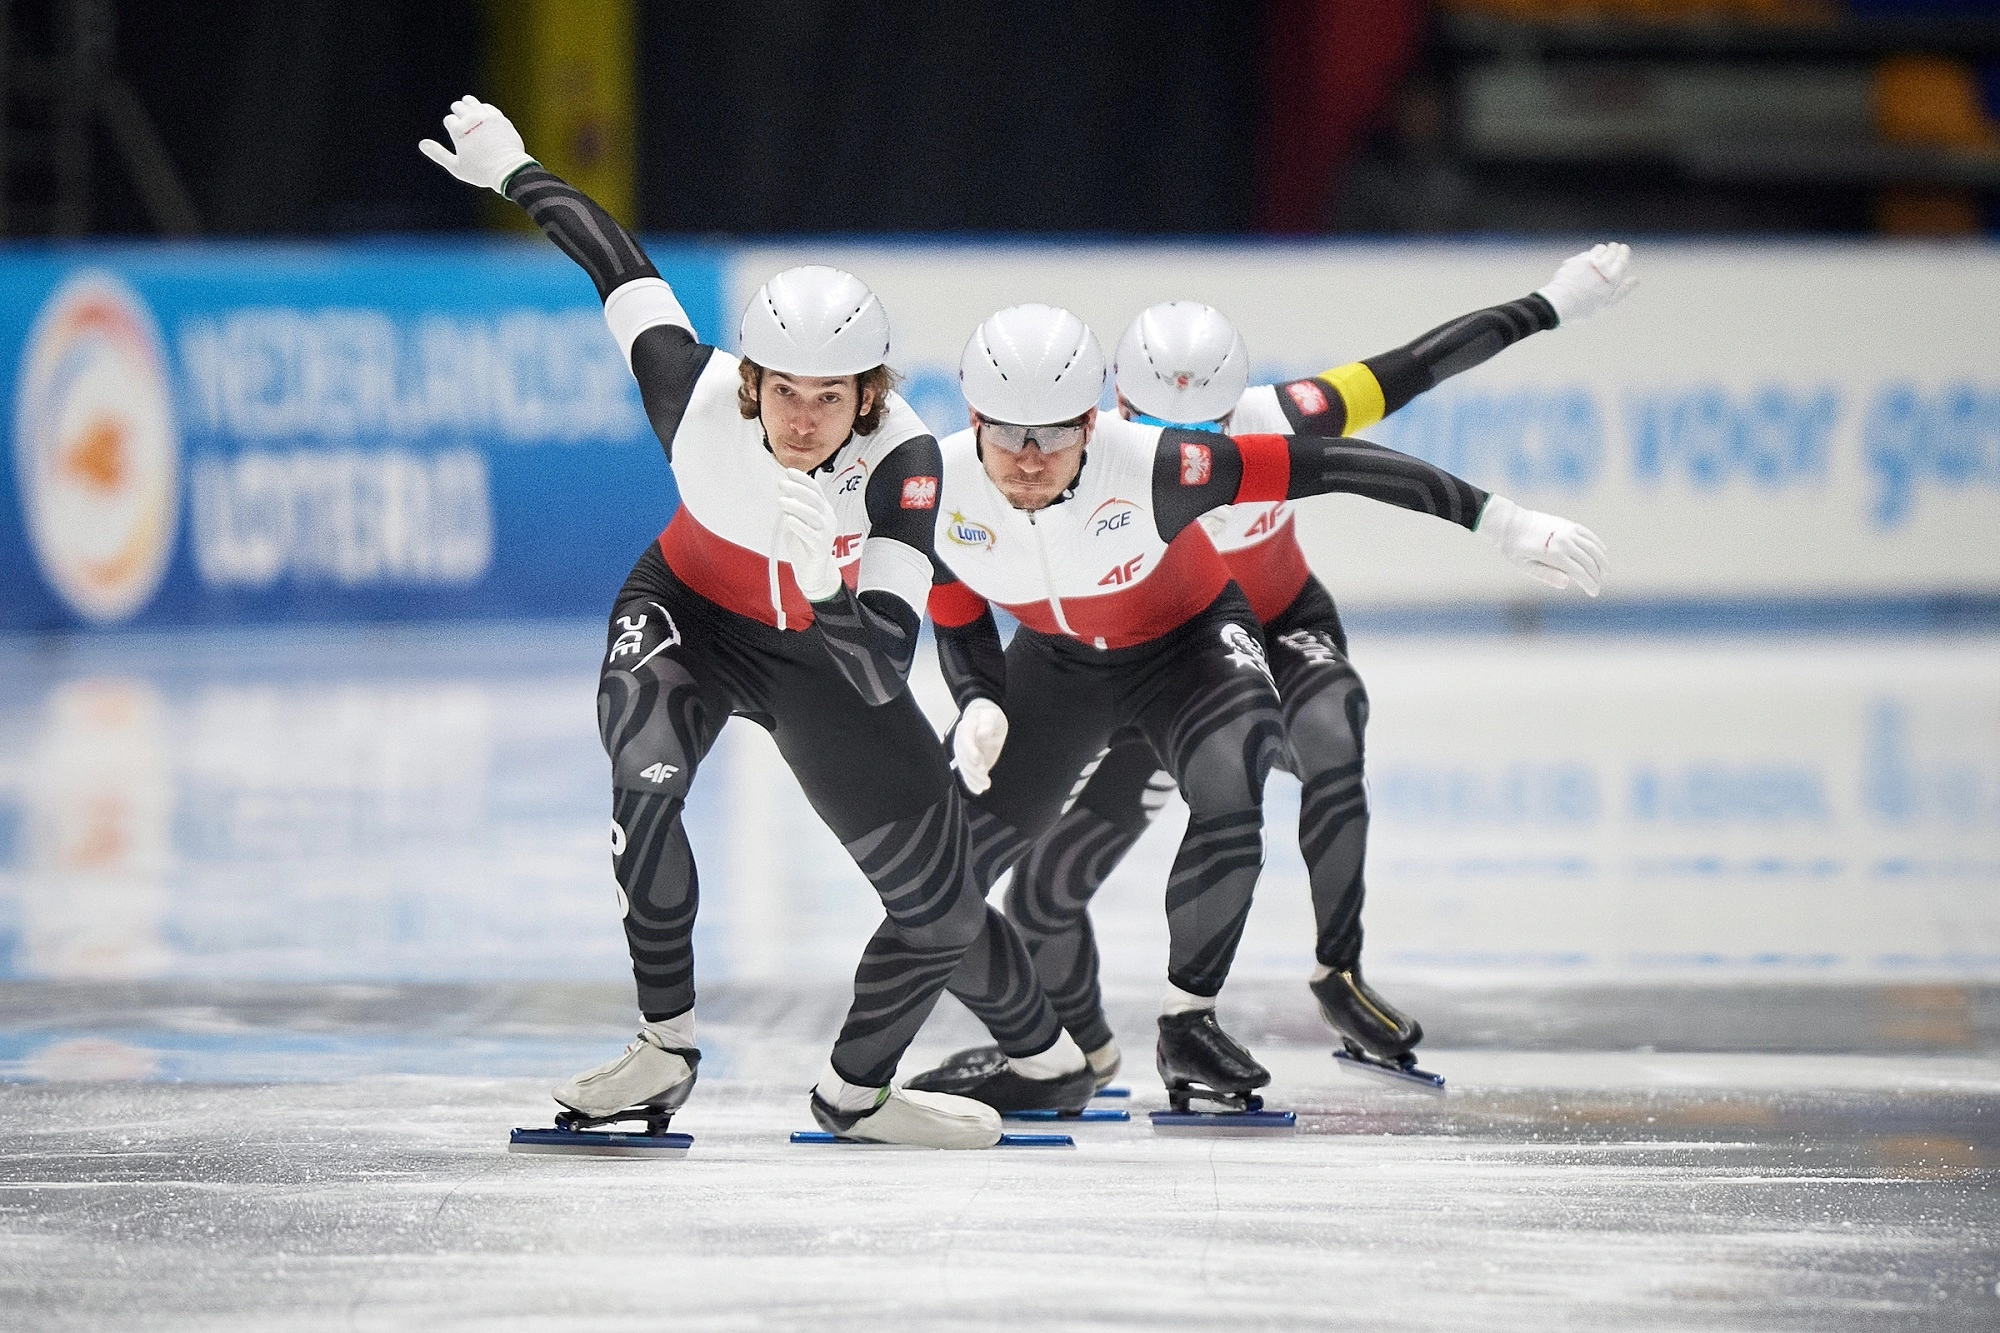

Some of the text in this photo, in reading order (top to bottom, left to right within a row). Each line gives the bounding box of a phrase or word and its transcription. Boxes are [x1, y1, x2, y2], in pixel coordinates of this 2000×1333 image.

[957, 525, 987, 541] LOTTO
[1096, 510, 1132, 536] PGE
[1097, 552, 1145, 586] 4F
[609, 614, 648, 663] PGE
[640, 762, 680, 784] 4F
